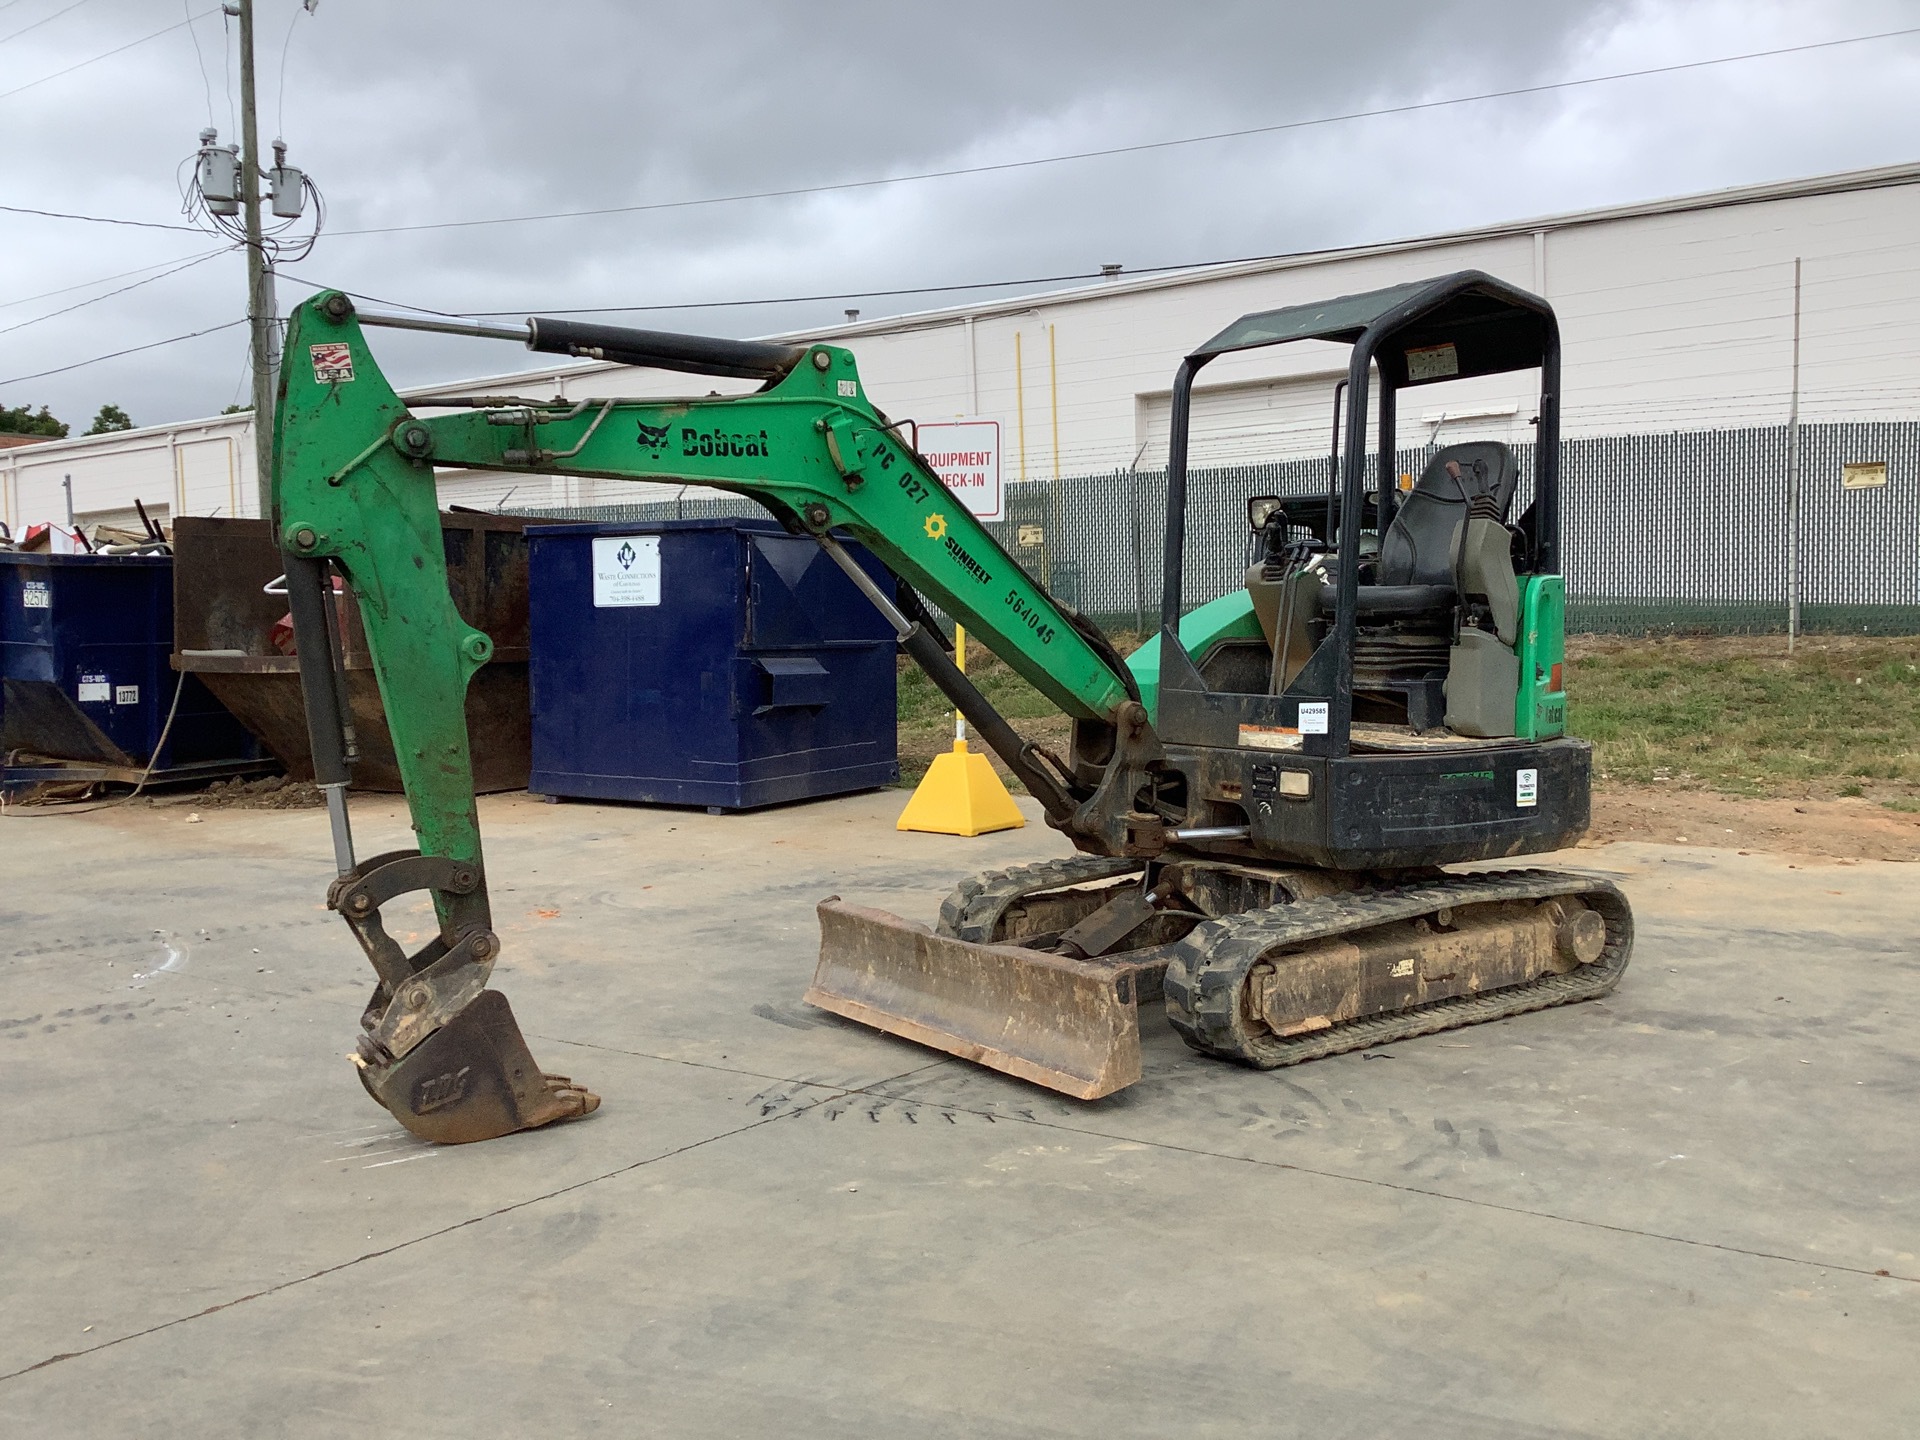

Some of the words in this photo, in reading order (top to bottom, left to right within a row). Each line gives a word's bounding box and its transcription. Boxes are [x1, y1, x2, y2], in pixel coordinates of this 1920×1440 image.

[317, 369, 351, 379] USA
[682, 428, 769, 457] Bobcat
[872, 443, 896, 470] PC
[899, 472, 930, 504] 027
[938, 473, 985, 487] HECK-IN
[945, 536, 993, 585] SUNBELT
[947, 551, 981, 584] RENTALS
[1005, 589, 1055, 645] 564045
[118, 690, 137, 702] 13772
